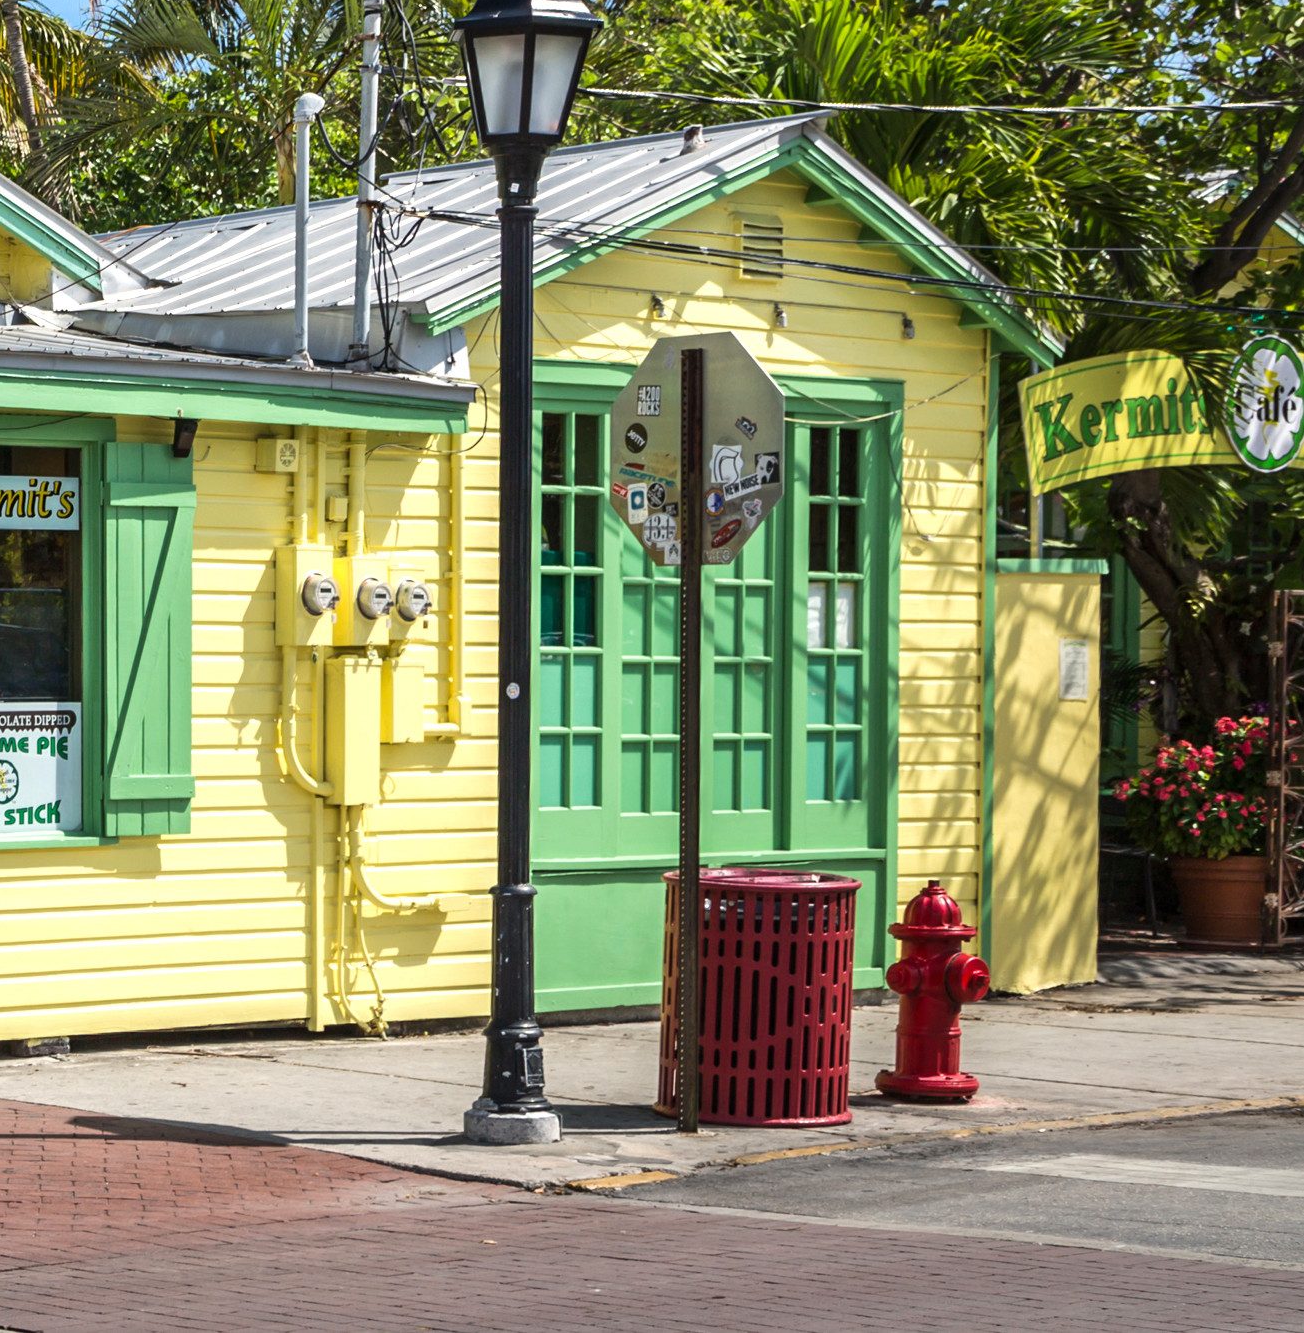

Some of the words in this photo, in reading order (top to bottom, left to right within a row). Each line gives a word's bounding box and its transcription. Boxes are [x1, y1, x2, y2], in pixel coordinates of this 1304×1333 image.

[637, 401, 660, 415] ROCKS
[34, 714, 71, 726] DIPPED
[37, 736, 69, 760] PIE
[4, 800, 61, 825] STICK
